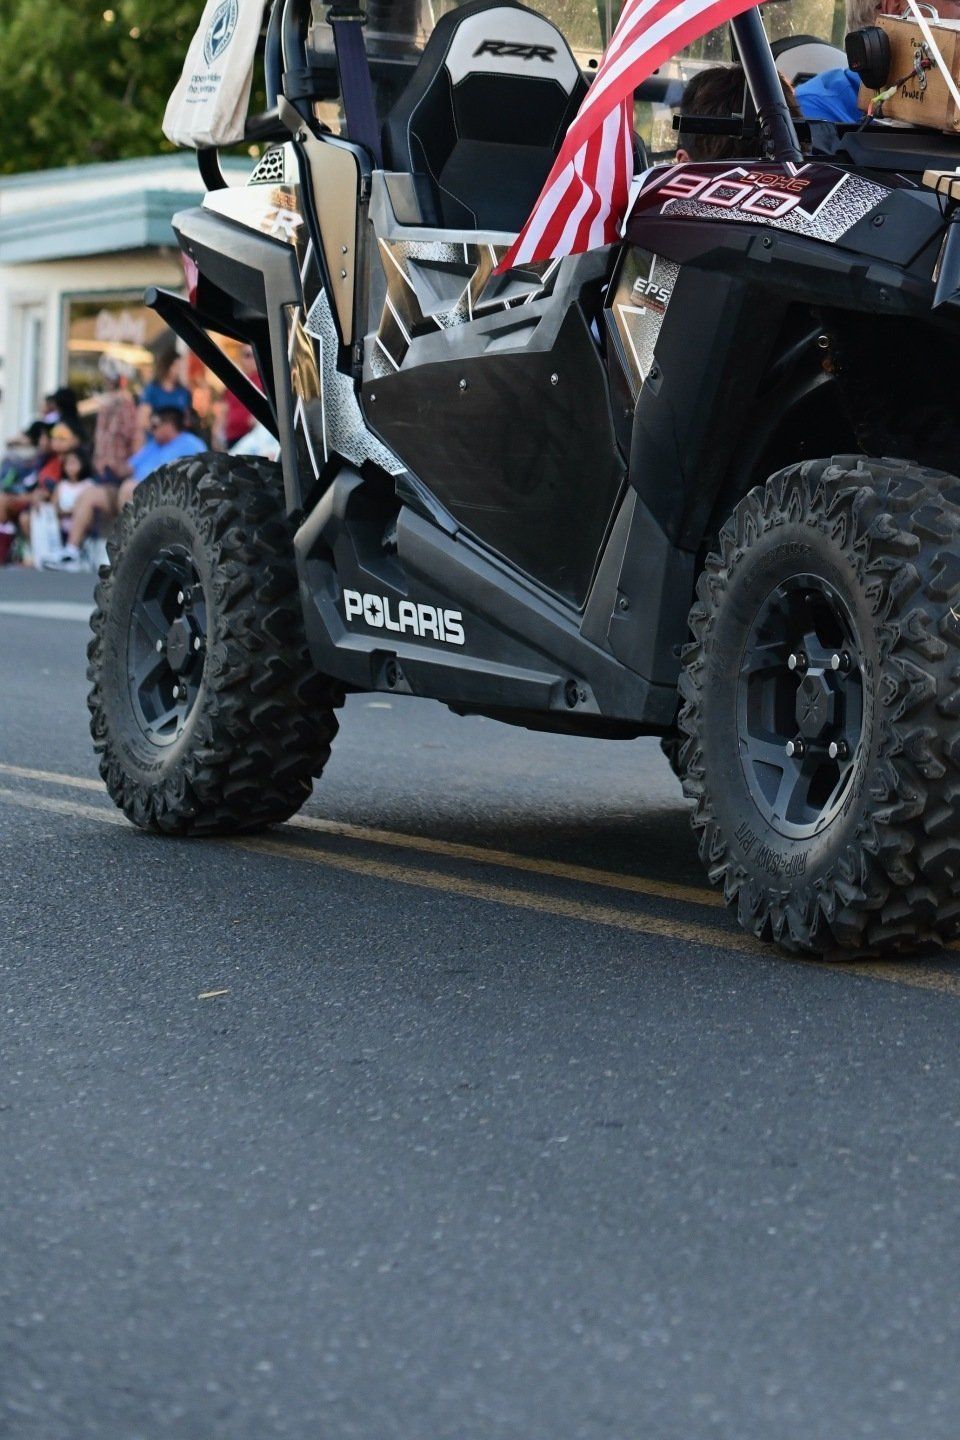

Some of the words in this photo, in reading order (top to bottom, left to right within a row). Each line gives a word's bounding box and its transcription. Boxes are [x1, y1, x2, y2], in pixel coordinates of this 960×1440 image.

[472, 39, 558, 63] RZR
[658, 173, 802, 218] 900
[633, 276, 671, 303] EPS
[343, 588, 466, 646] POLARIS
